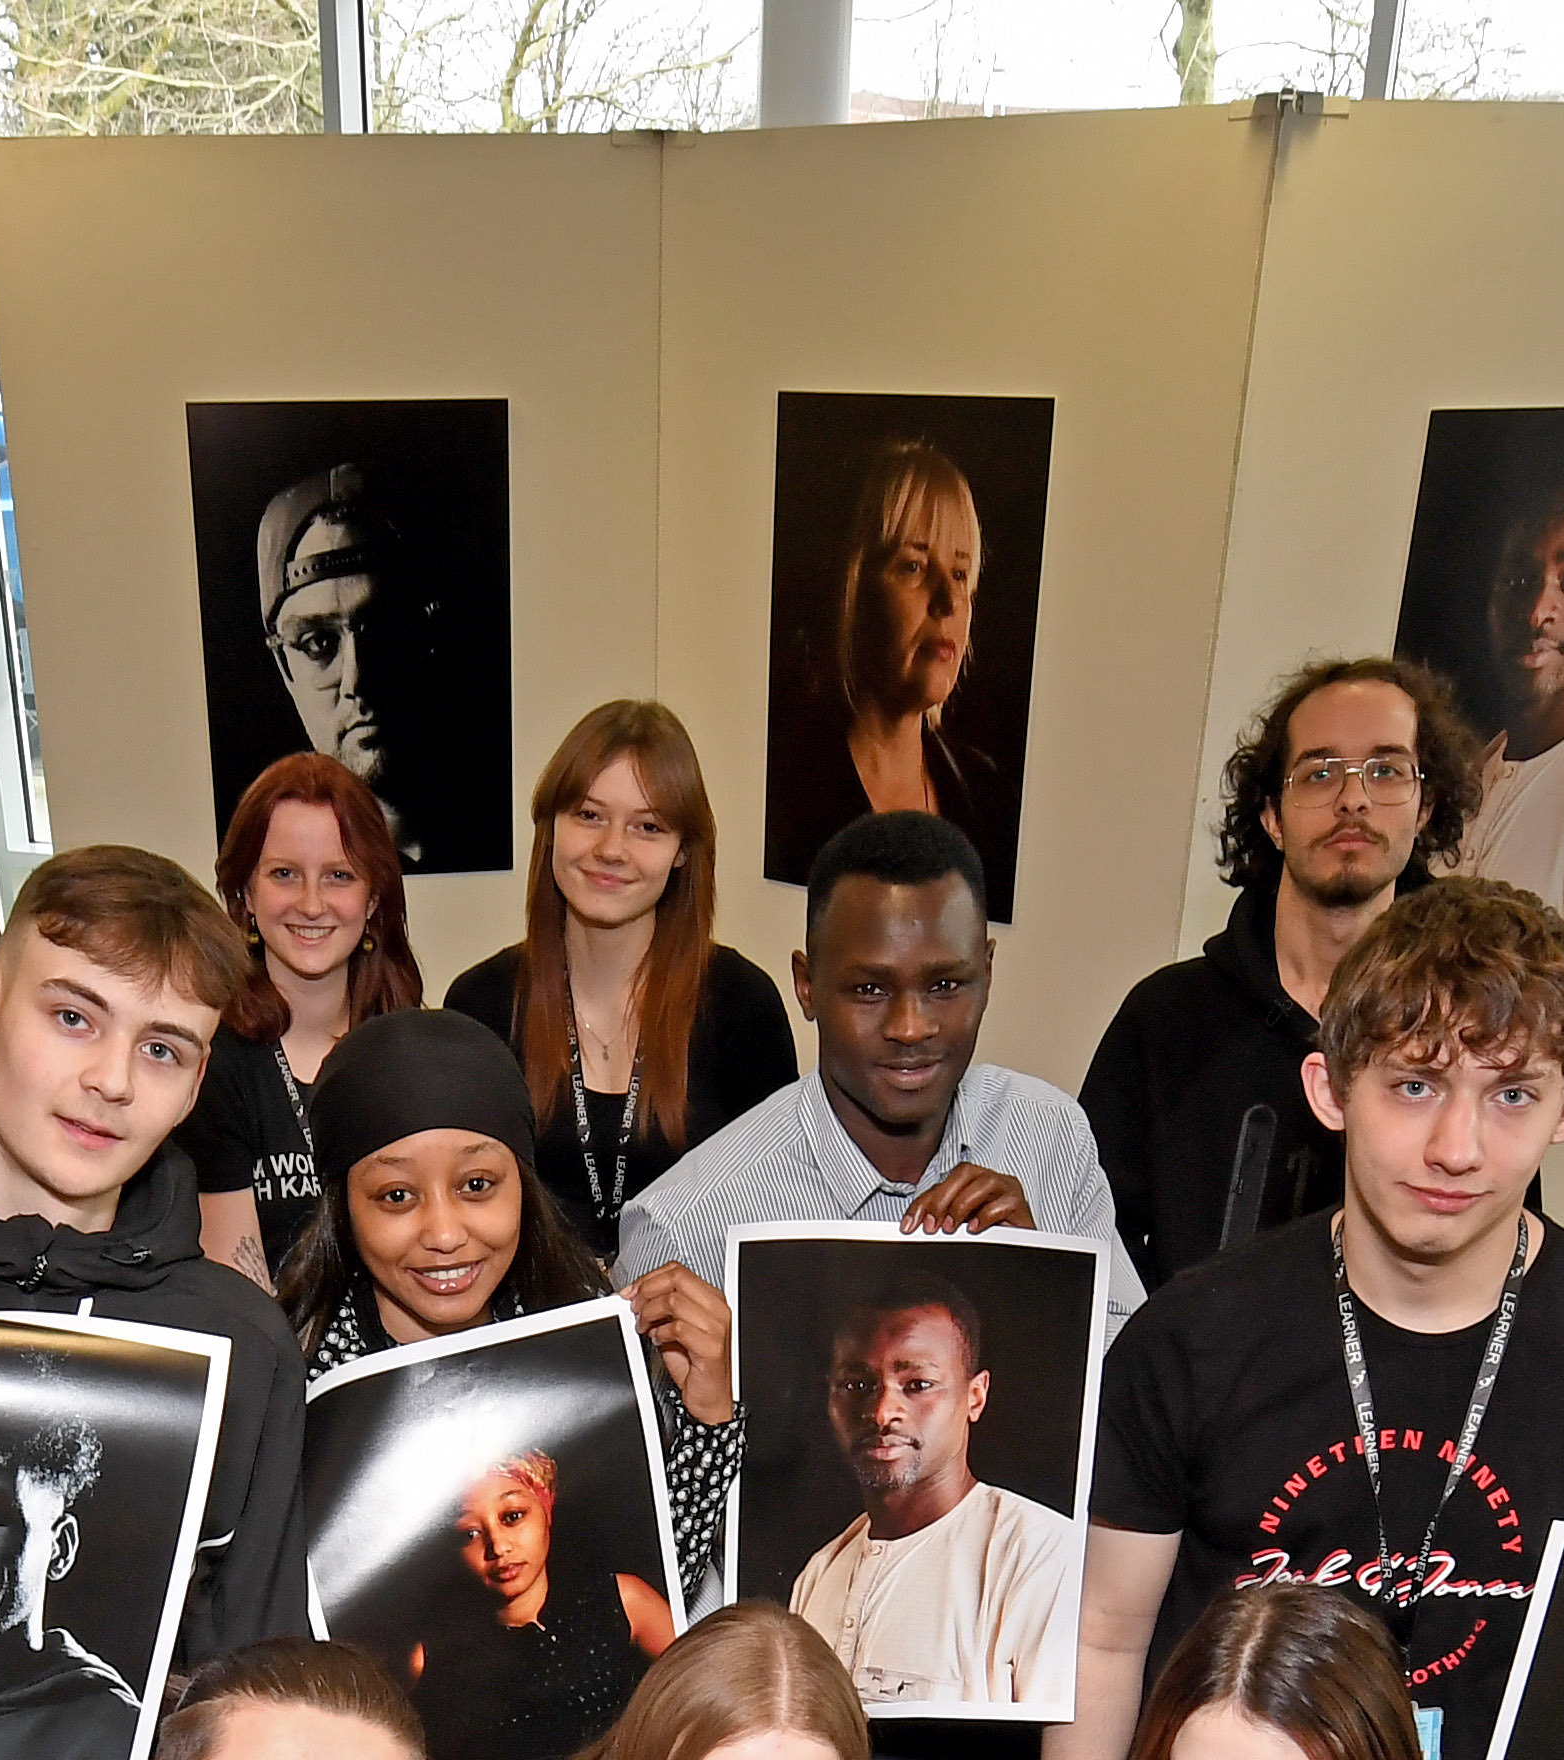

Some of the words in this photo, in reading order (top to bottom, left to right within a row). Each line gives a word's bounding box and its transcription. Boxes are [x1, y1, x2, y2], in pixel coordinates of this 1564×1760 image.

[274, 1050, 299, 1101] LEARNER
[572, 1074, 588, 1126] LEARNER
[621, 1077, 640, 1129] LEARNER
[584, 1153, 603, 1203] LEARNER
[612, 1156, 626, 1204] LEARNER
[1338, 1293, 1363, 1364] LEARNER
[1486, 1292, 1517, 1365] LEARNER
[1357, 1402, 1380, 1475] LEARNER
[1452, 1404, 1485, 1477] LEARNER
